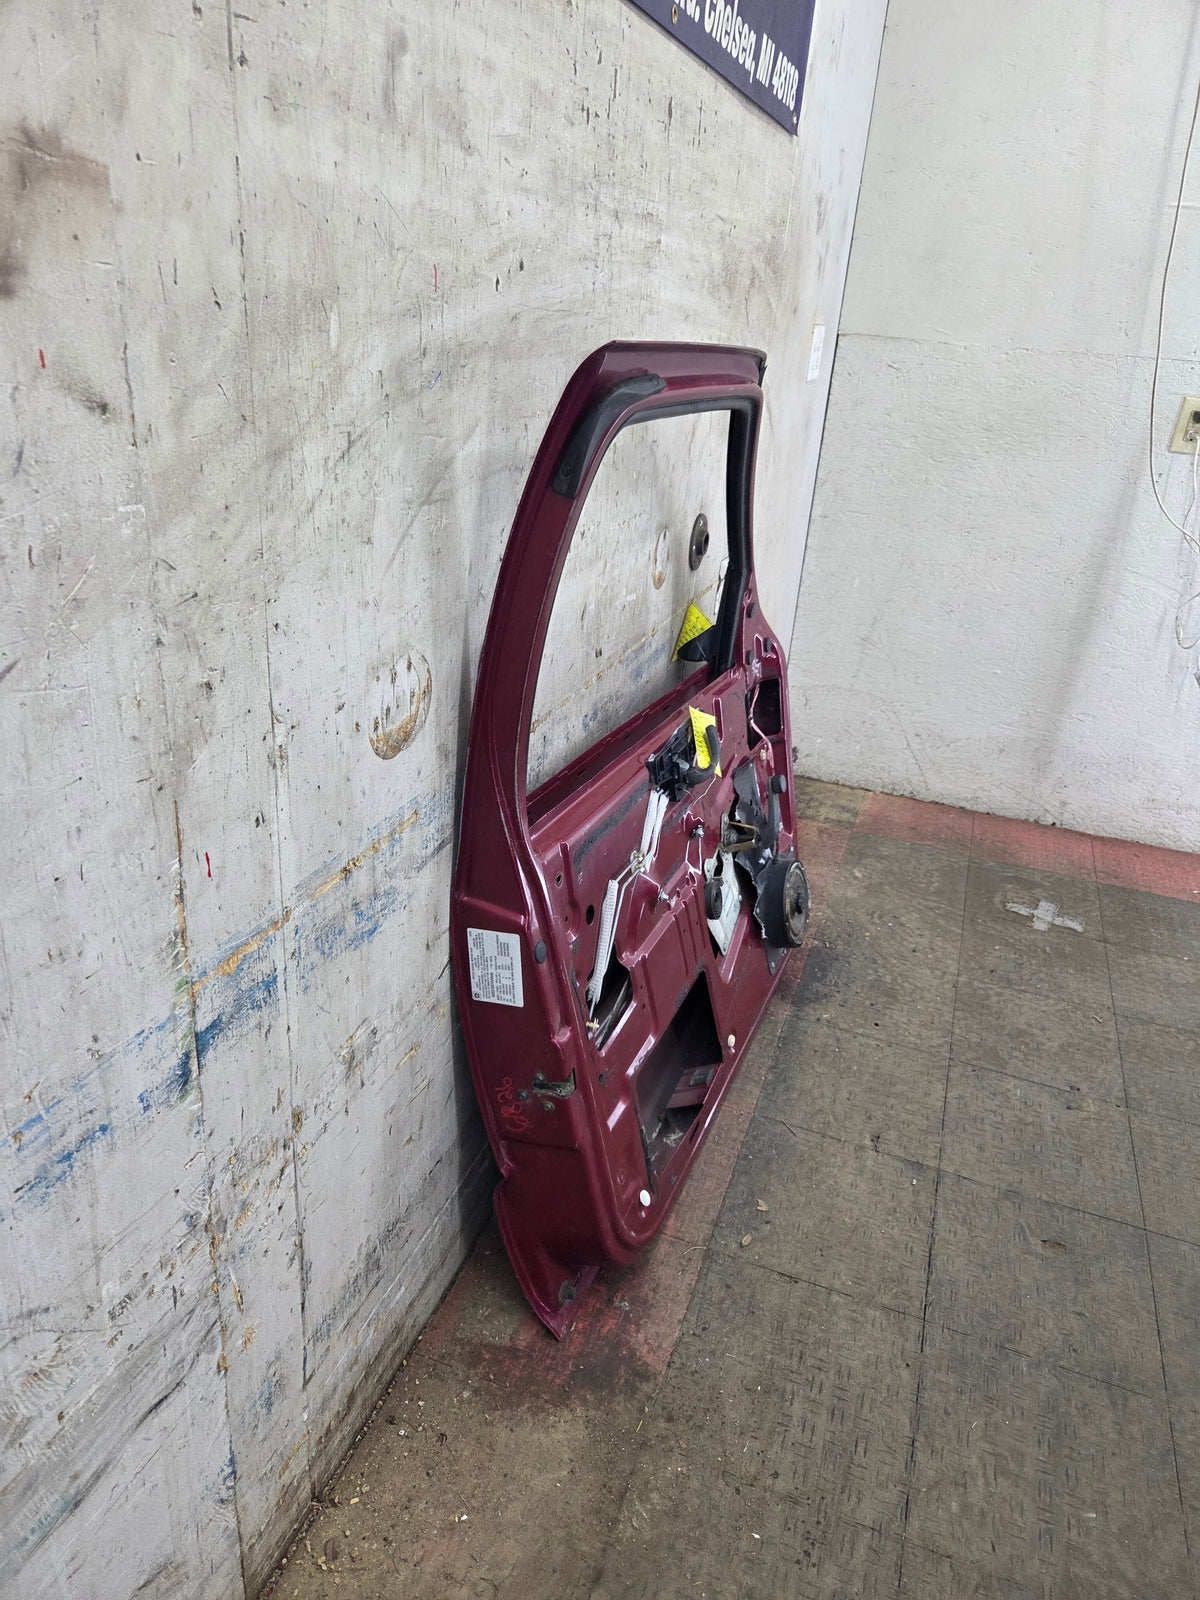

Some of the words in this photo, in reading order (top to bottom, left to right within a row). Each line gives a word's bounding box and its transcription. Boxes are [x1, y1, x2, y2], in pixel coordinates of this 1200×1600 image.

[704, 0, 757, 84] Chelsea,
[756, 33, 775, 88] MI
[772, 51, 799, 111] 48118
